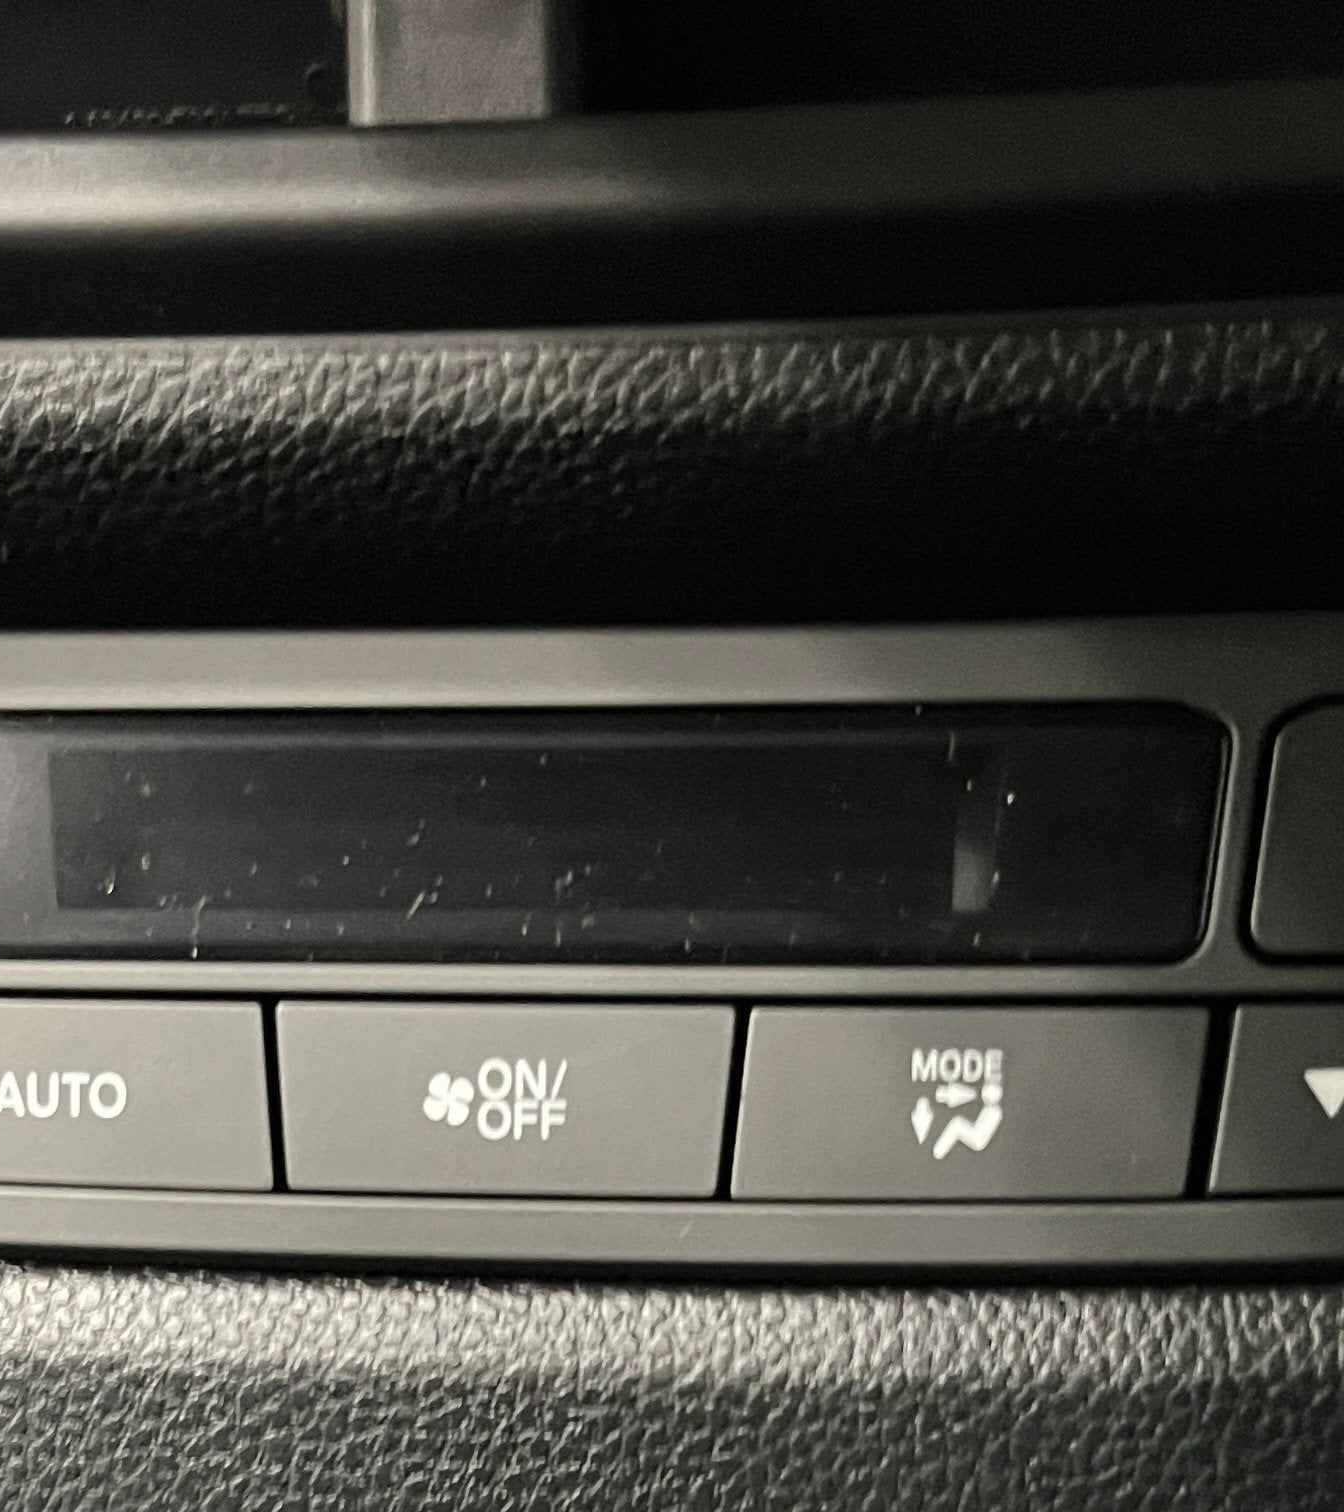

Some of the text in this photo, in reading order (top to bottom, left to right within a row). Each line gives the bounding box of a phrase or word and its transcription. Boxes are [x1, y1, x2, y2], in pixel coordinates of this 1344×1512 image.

[478, 1056, 568, 1100] ON/
[911, 1048, 1004, 1082] MODE
[477, 1099, 567, 1141] OFF
